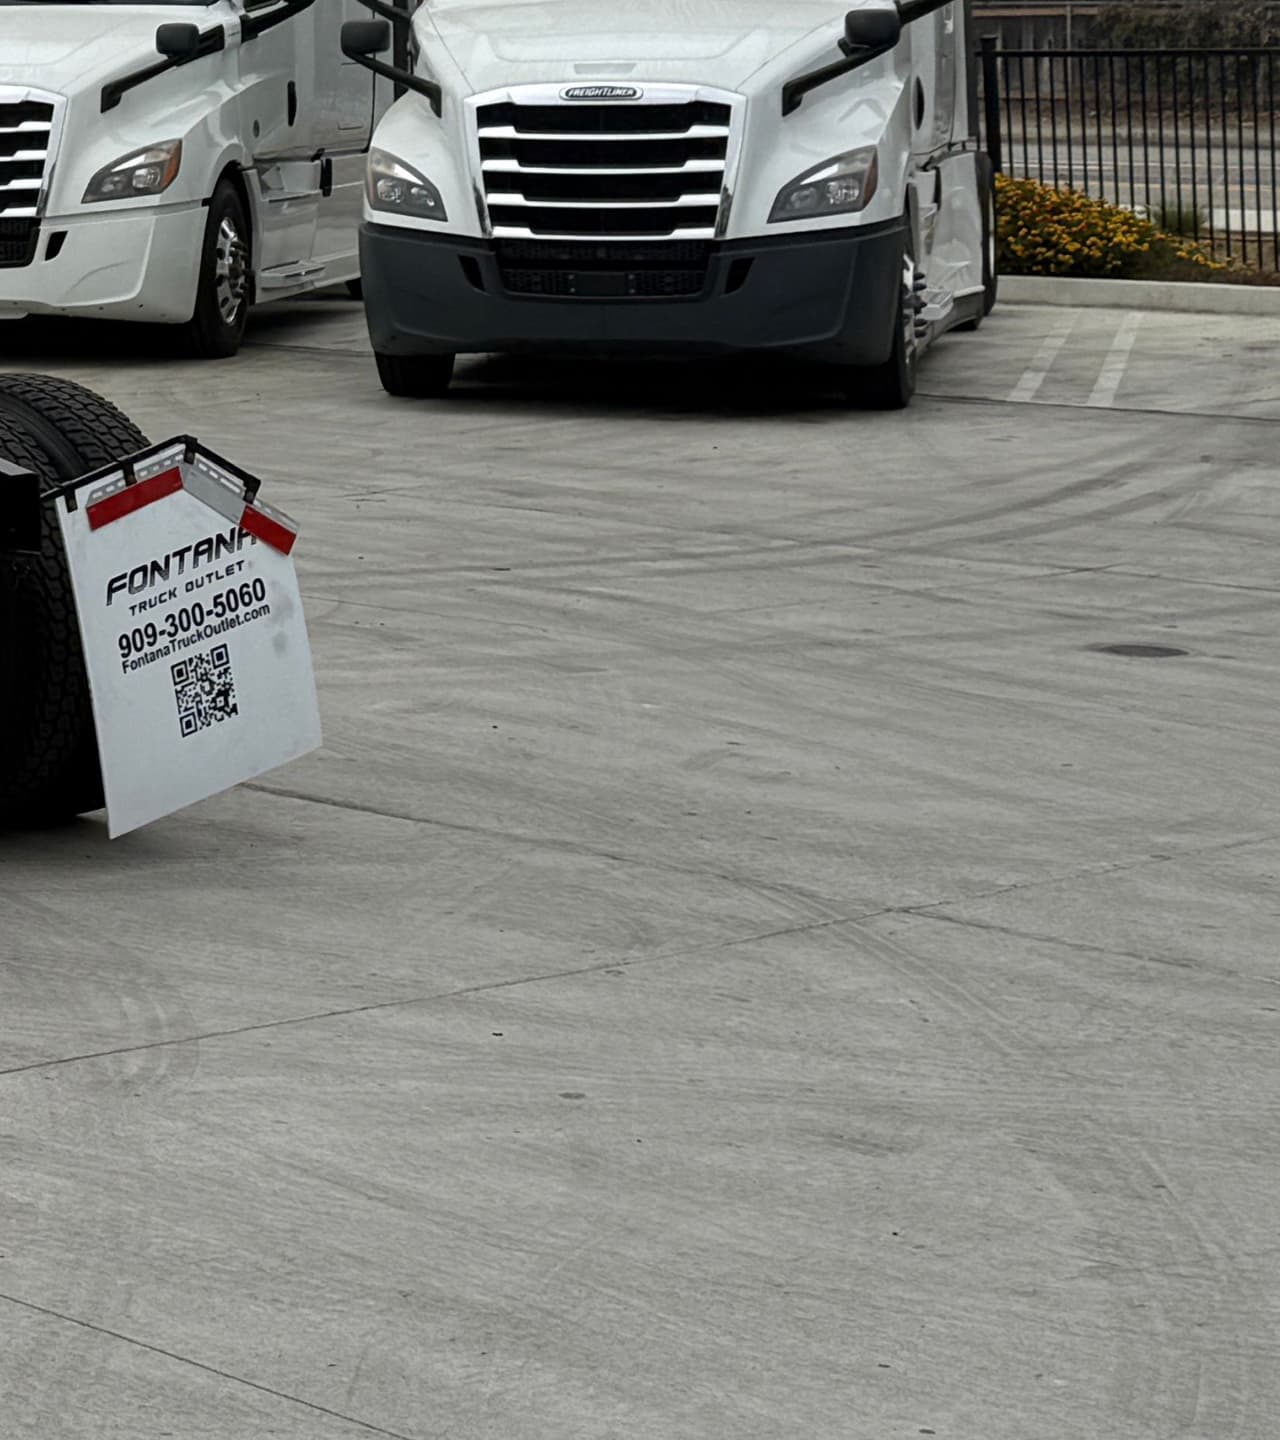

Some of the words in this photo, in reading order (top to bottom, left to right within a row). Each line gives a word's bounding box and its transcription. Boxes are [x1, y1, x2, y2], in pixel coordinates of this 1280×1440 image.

[568, 87, 634, 97] FREIGHTLINER
[118, 578, 266, 658] 909-300-5060
[129, 587, 178, 616] TRUCK
[185, 560, 245, 593] OUTLET
[121, 604, 271, 674] FontanaTruckOutlet.com
